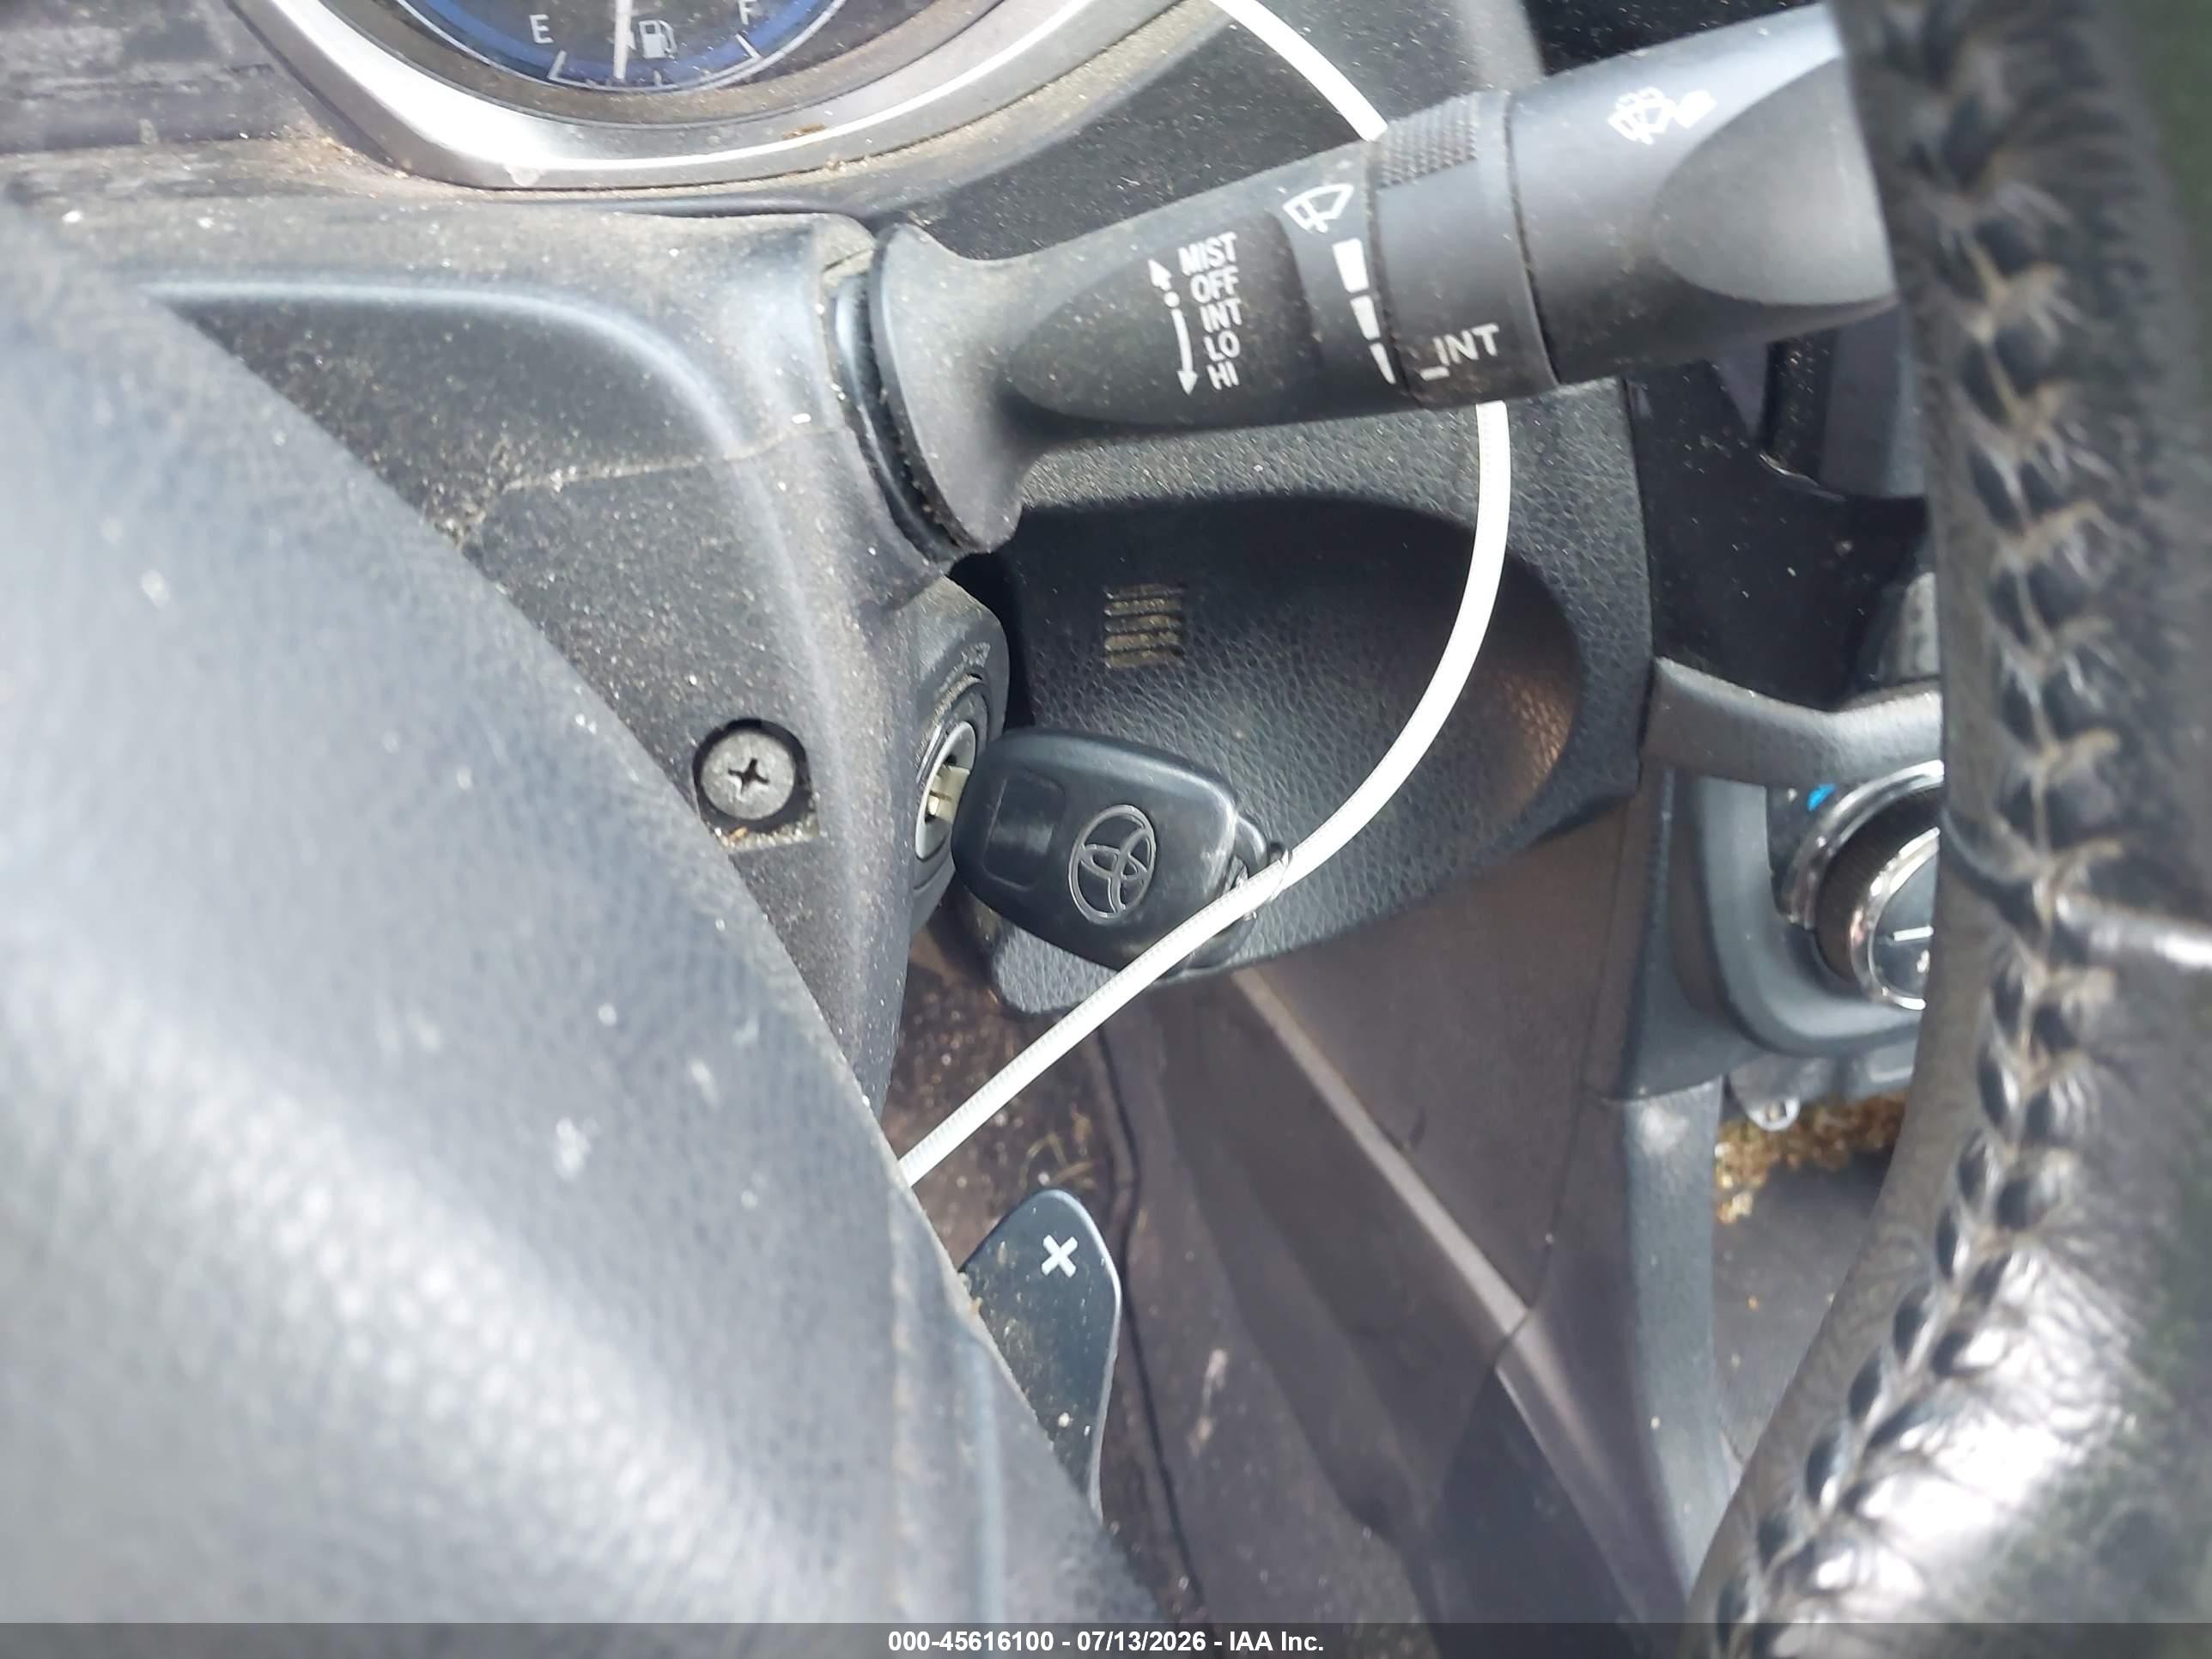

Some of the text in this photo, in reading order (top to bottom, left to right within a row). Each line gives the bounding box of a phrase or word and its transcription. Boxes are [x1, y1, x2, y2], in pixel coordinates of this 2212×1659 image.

[530, 13, 552, 45] E
[1178, 231, 1237, 276] MIST
[1190, 265, 1239, 303] OFF
[1200, 297, 1243, 333] INT
[1204, 330, 1240, 362] LO
[1432, 323, 1499, 366] INT
[1206, 361, 1240, 390] HI
